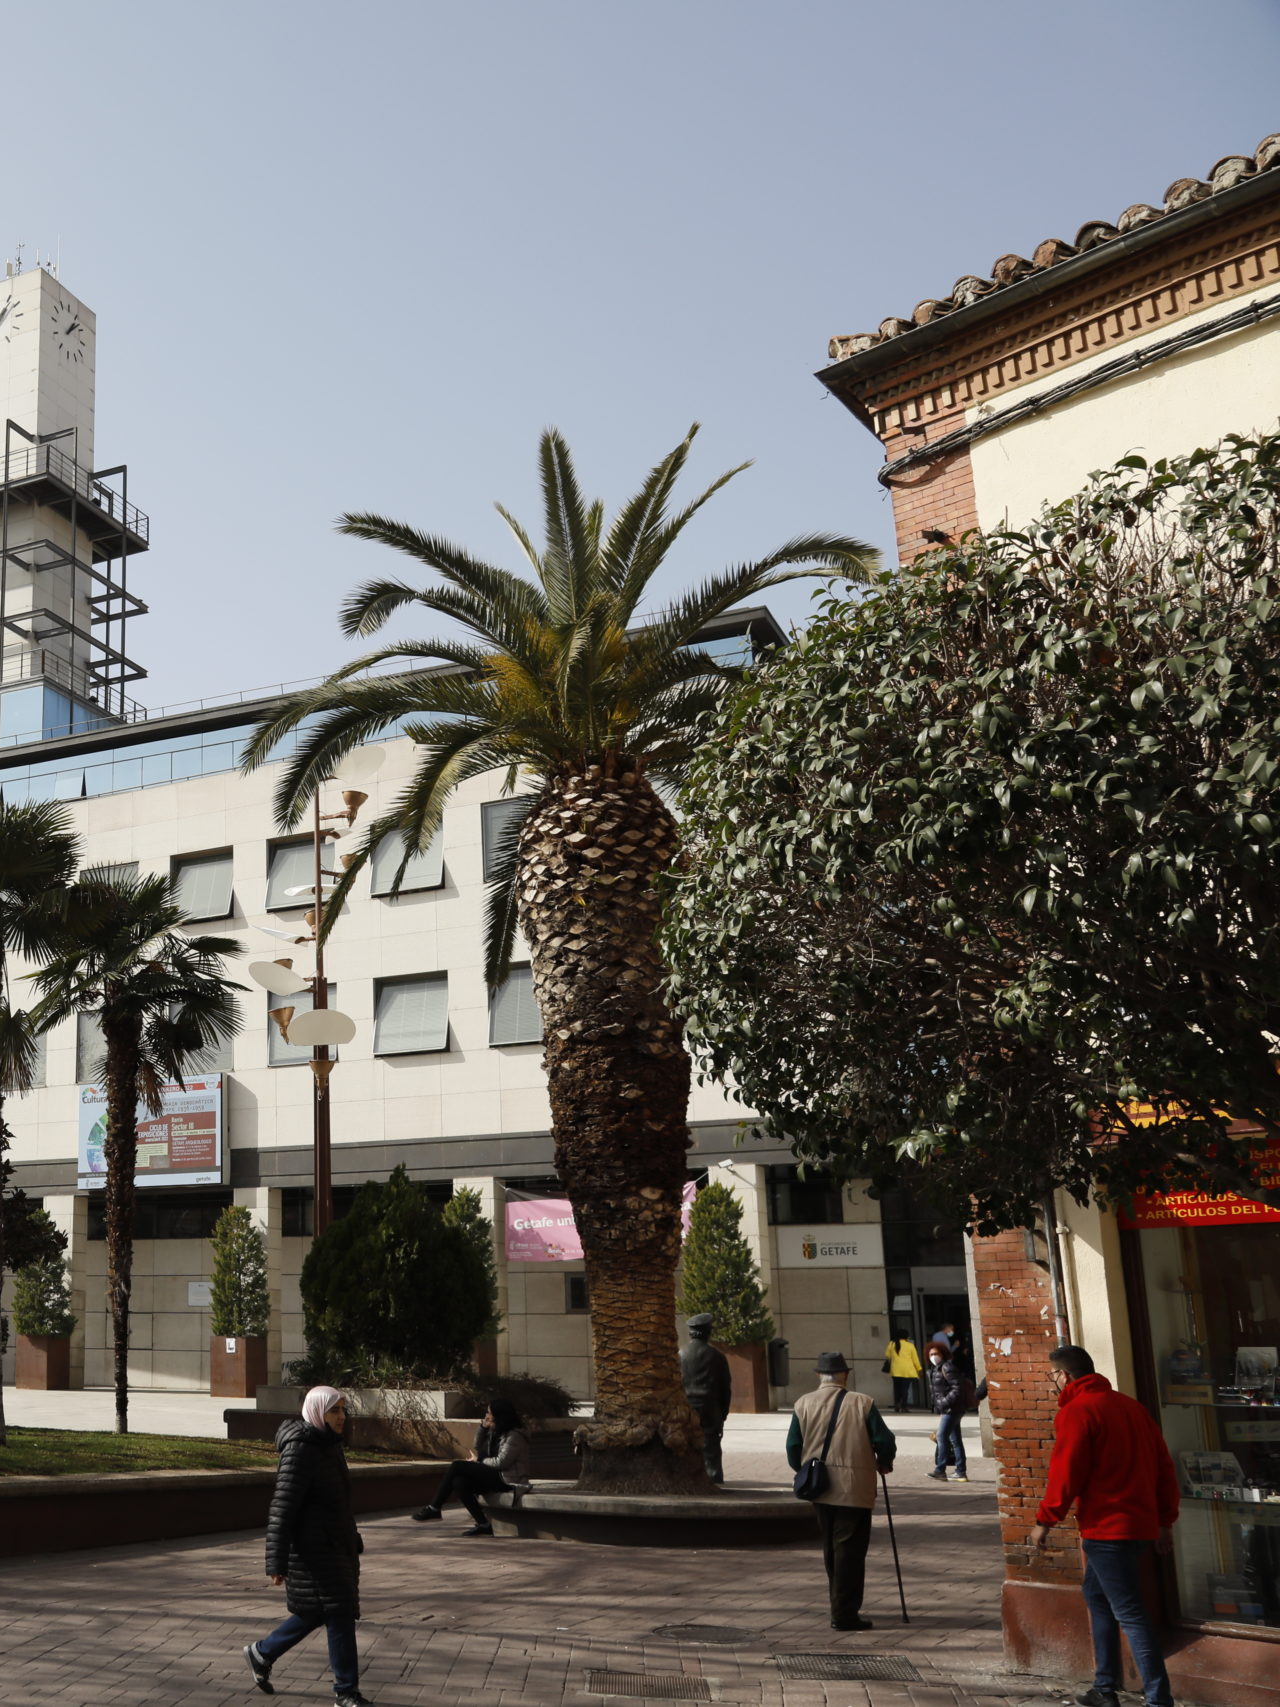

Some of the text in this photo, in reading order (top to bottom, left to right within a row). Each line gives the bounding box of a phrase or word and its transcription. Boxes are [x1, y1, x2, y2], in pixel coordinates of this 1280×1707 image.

[1146, 1206, 1227, 1220] ARTÍCULOS
[1231, 1204, 1261, 1215] DEL
[513, 1216, 553, 1231] Getafe
[820, 1246, 858, 1256] GETAFE
